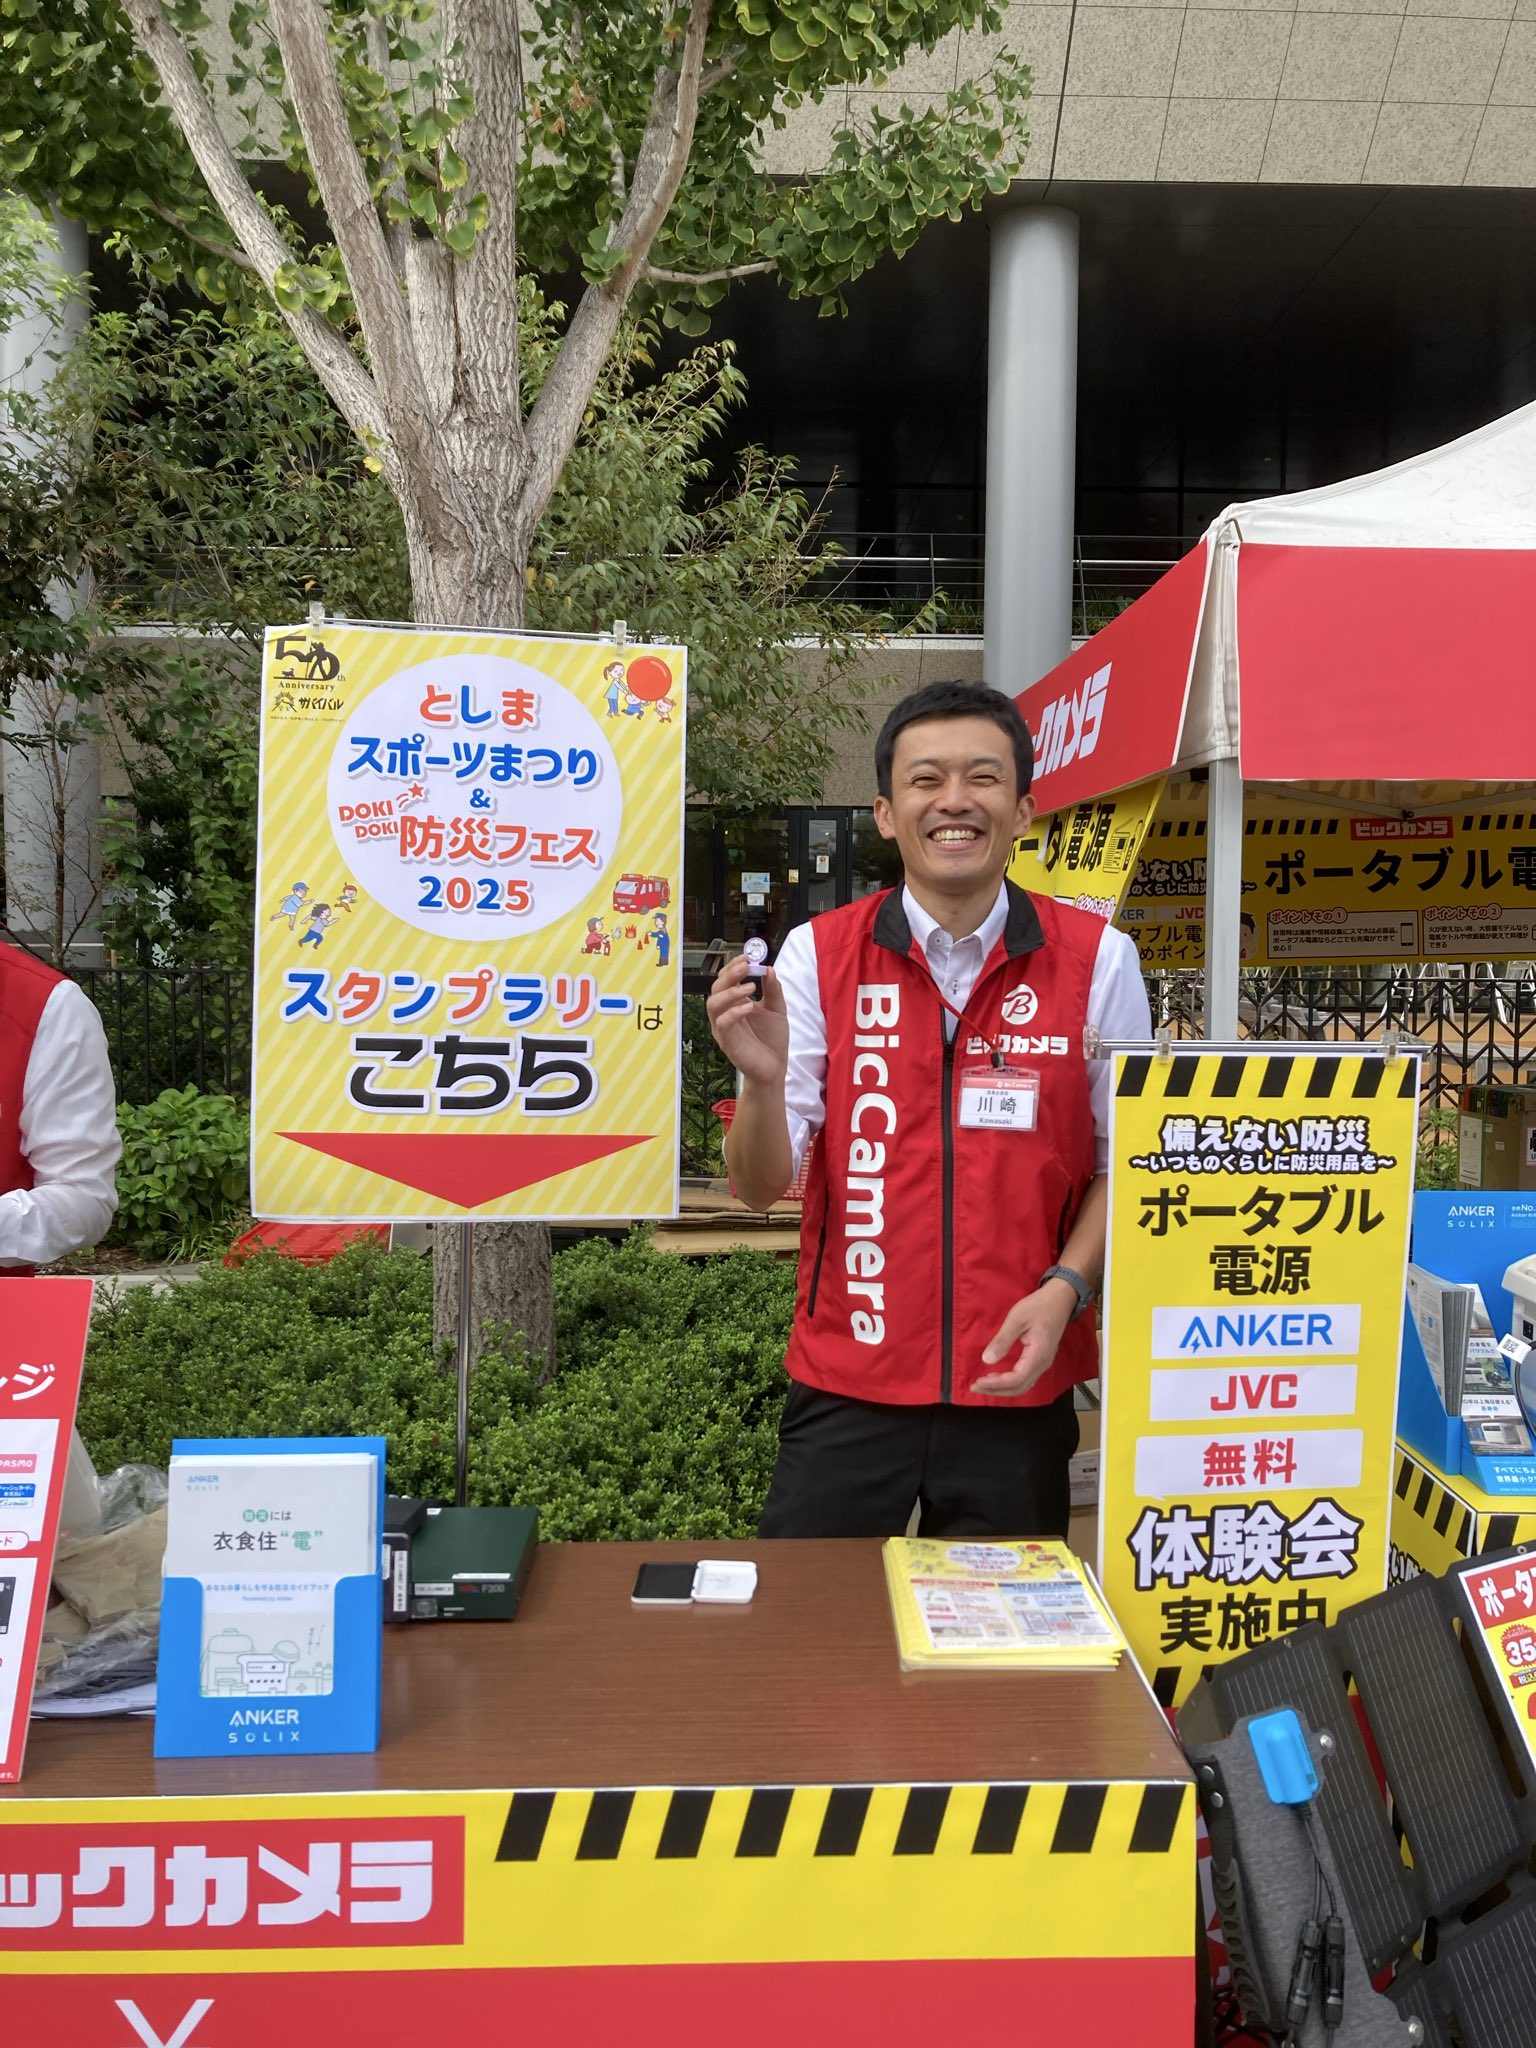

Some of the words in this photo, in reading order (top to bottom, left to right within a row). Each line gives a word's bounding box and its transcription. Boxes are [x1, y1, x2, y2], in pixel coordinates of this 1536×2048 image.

[278, 681, 336, 692] Anniversary
[419, 684, 536, 727] としま
[347, 733, 599, 786] スポーツまつり
[338, 800, 394, 822] DOKI
[469, 788, 491, 809] &
[355, 820, 399, 838] DOKI
[398, 816, 598, 865] 防災フェス
[1355, 820, 1448, 837] ビックカメラ
[1264, 846, 1536, 895] ポータブル電
[418, 875, 531, 911] 2025
[1175, 907, 1204, 920] JVC
[1270, 910, 1311, 923] ポイント
[1425, 908, 1467, 919] ポイント
[285, 969, 664, 1031] スタンプラリーは
[349, 1035, 593, 1111] こちら
[979, 1117, 1012, 1125] Kawasaki
[1160, 1117, 1370, 1152] 備えない防災
[844, 983, 900, 1345] BicCamera
[1137, 1184, 1385, 1237] ポータブル
[1447, 1220, 1495, 1228] SOLIX
[1448, 1205, 1495, 1217] ANKER
[1209, 1244, 1312, 1296] 電源
[1179, 1313, 1333, 1351] ANKER
[1210, 1373, 1298, 1411] JVC
[187, 1475, 220, 1483] ANKER
[1203, 1437, 1298, 1488] 無料
[1129, 1498, 1363, 1590] 体験会
[1478, 1567, 1536, 1618] ポータ
[1160, 1589, 1328, 1655] 実施中
[229, 1709, 300, 1727] ANKER
[228, 1731, 300, 1744] SOLIX
[0, 1840, 433, 1928] ックカメラ
